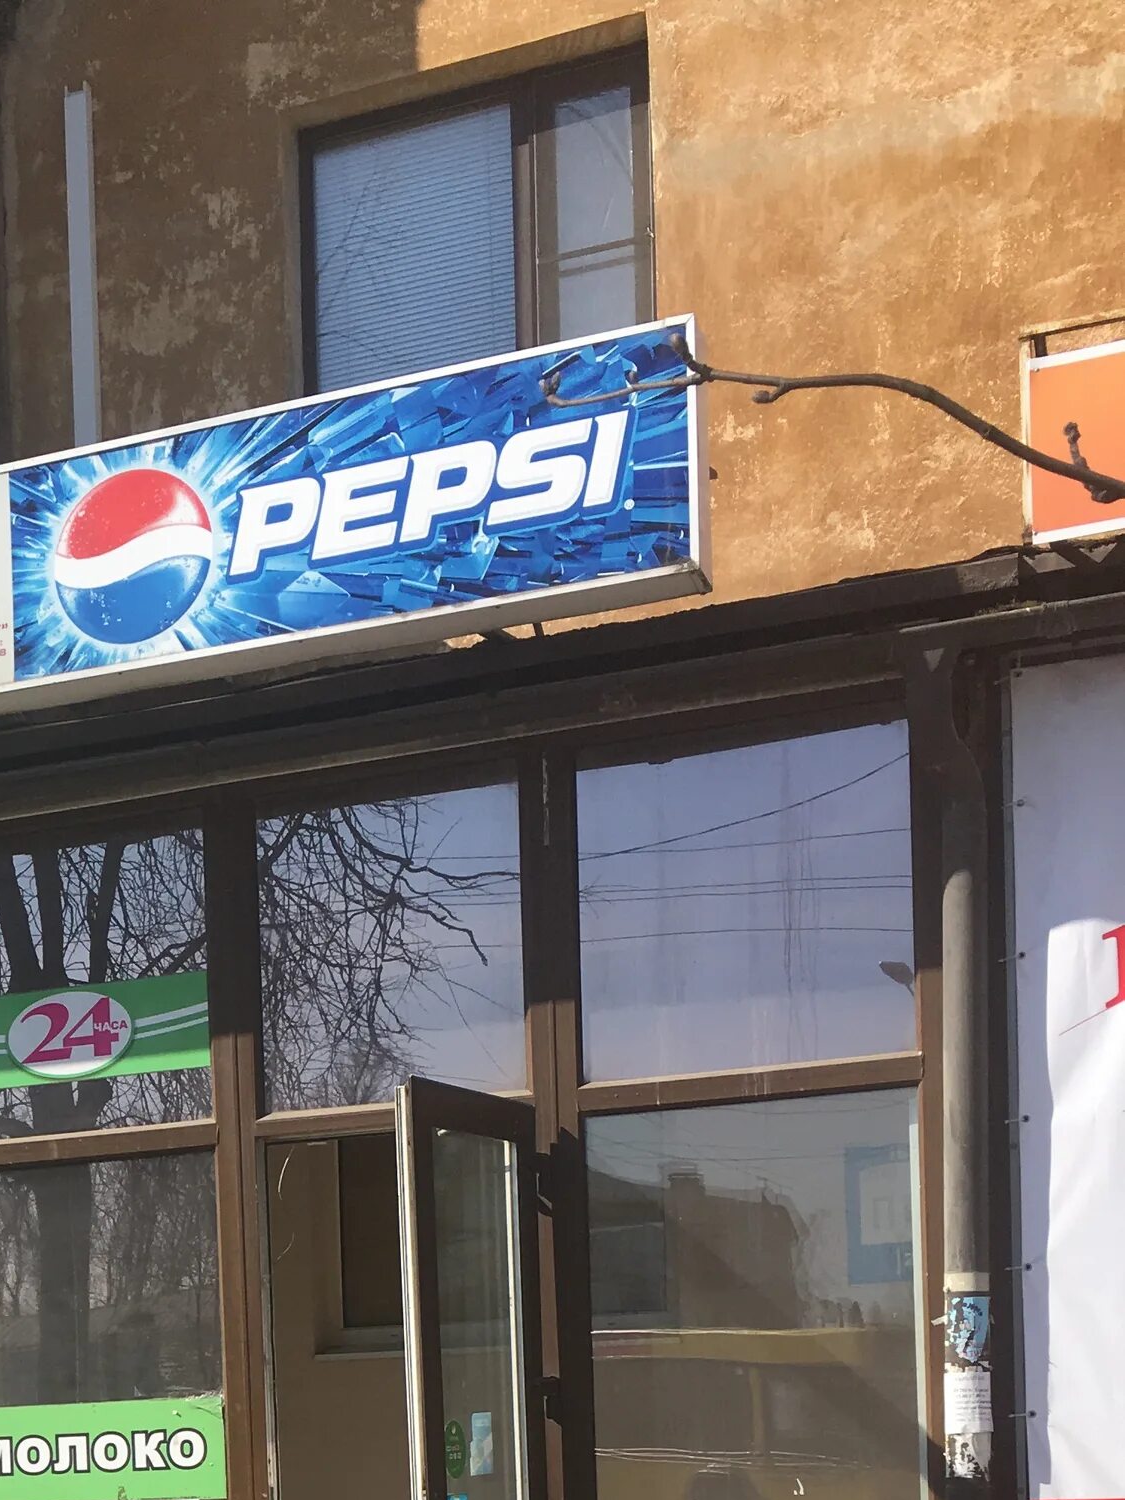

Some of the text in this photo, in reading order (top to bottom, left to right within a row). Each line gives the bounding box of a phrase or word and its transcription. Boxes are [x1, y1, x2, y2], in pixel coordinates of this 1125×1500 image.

[225, 412, 627, 577] PEPSI
[19, 996, 120, 1065] 24
[93, 1020, 128, 1032] ЧАСА
